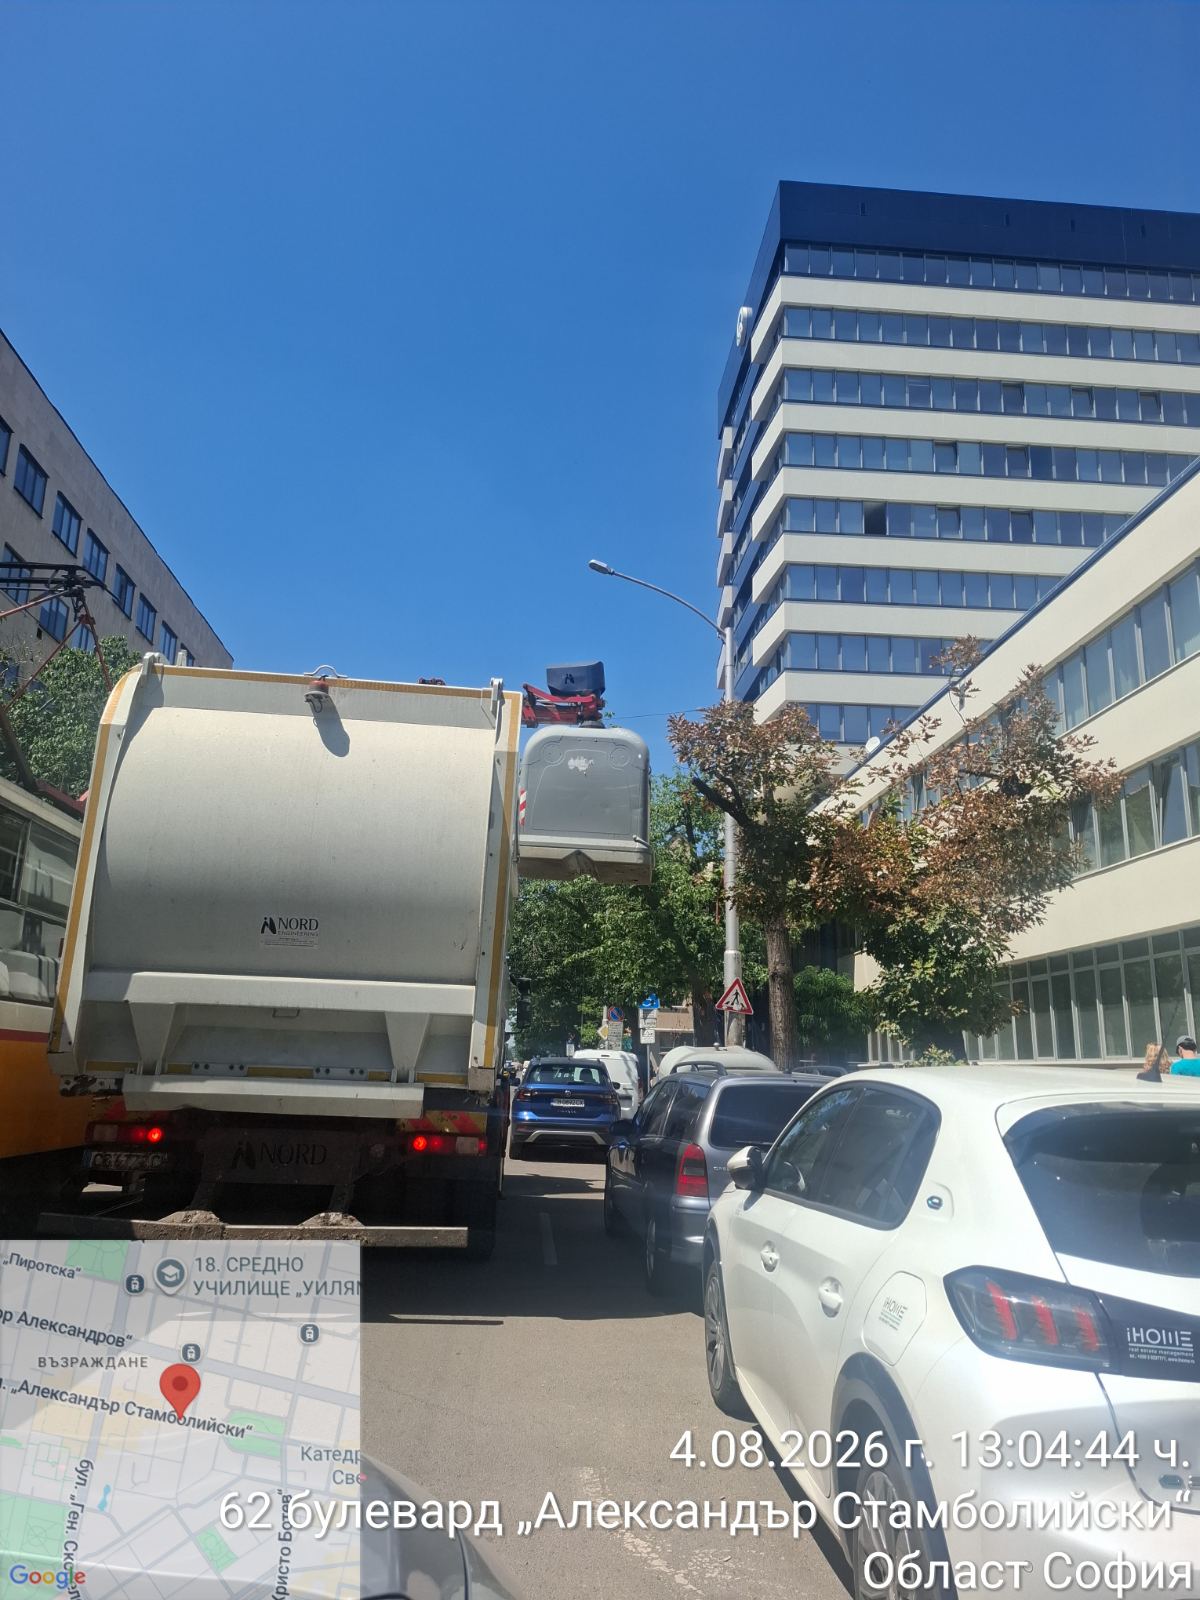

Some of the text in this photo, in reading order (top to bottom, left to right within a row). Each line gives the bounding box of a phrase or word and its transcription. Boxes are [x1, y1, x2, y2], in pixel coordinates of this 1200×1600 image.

[278, 917, 319, 931] NORD
[261, 1142, 328, 1165] NORD
[1127, 1327, 1193, 1347] iHOME
